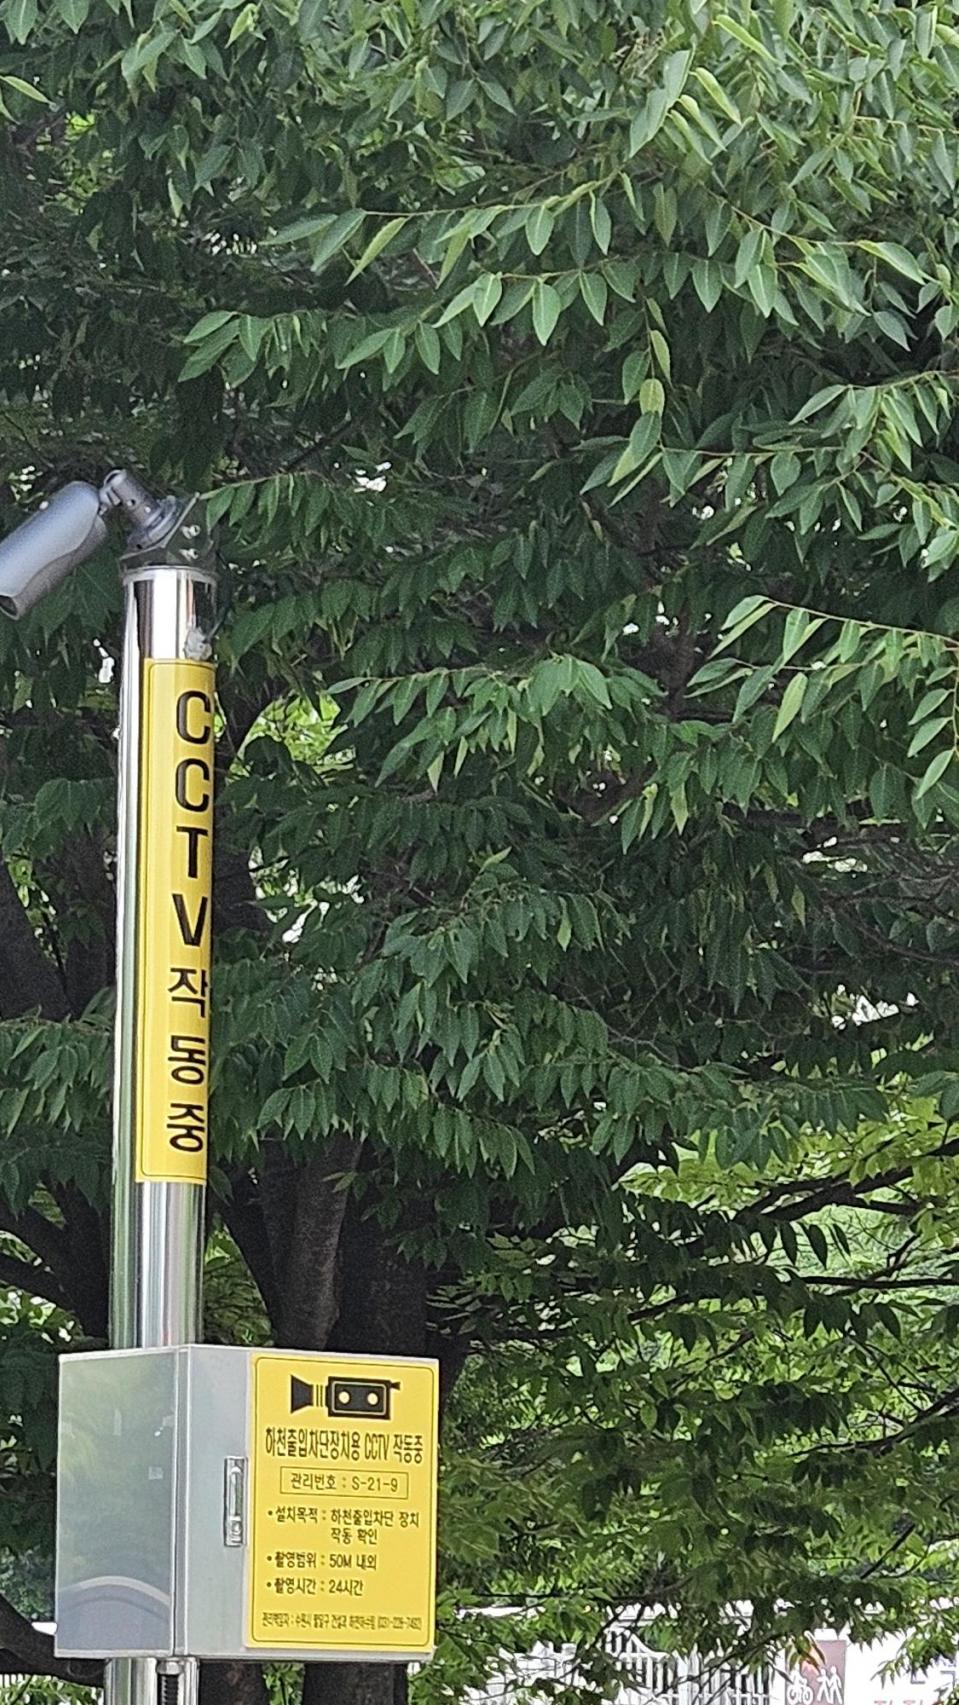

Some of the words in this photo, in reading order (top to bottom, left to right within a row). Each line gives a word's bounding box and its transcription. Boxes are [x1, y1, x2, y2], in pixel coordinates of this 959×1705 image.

[266, 1427, 361, 1462] 하천출입차단장치용
[364, 1432, 390, 1461] CCTV
[393, 1434, 423, 1464] 작동중
[290, 1473, 337, 1490] 관리번호
[352, 1476, 398, 1493] S-21-9
[275, 1506, 318, 1523] 설치목적
[330, 1508, 394, 1527] 하천출입차단
[398, 1511, 419, 1528] 장치
[330, 1527, 352, 1544] 작동
[357, 1528, 377, 1545] 확인
[274, 1551, 317, 1568] 촬영범위
[329, 1554, 352, 1568] 50M
[356, 1554, 377, 1570] 내외
[274, 1577, 317, 1594] 촬영시간
[329, 1579, 363, 1596] 24시간
